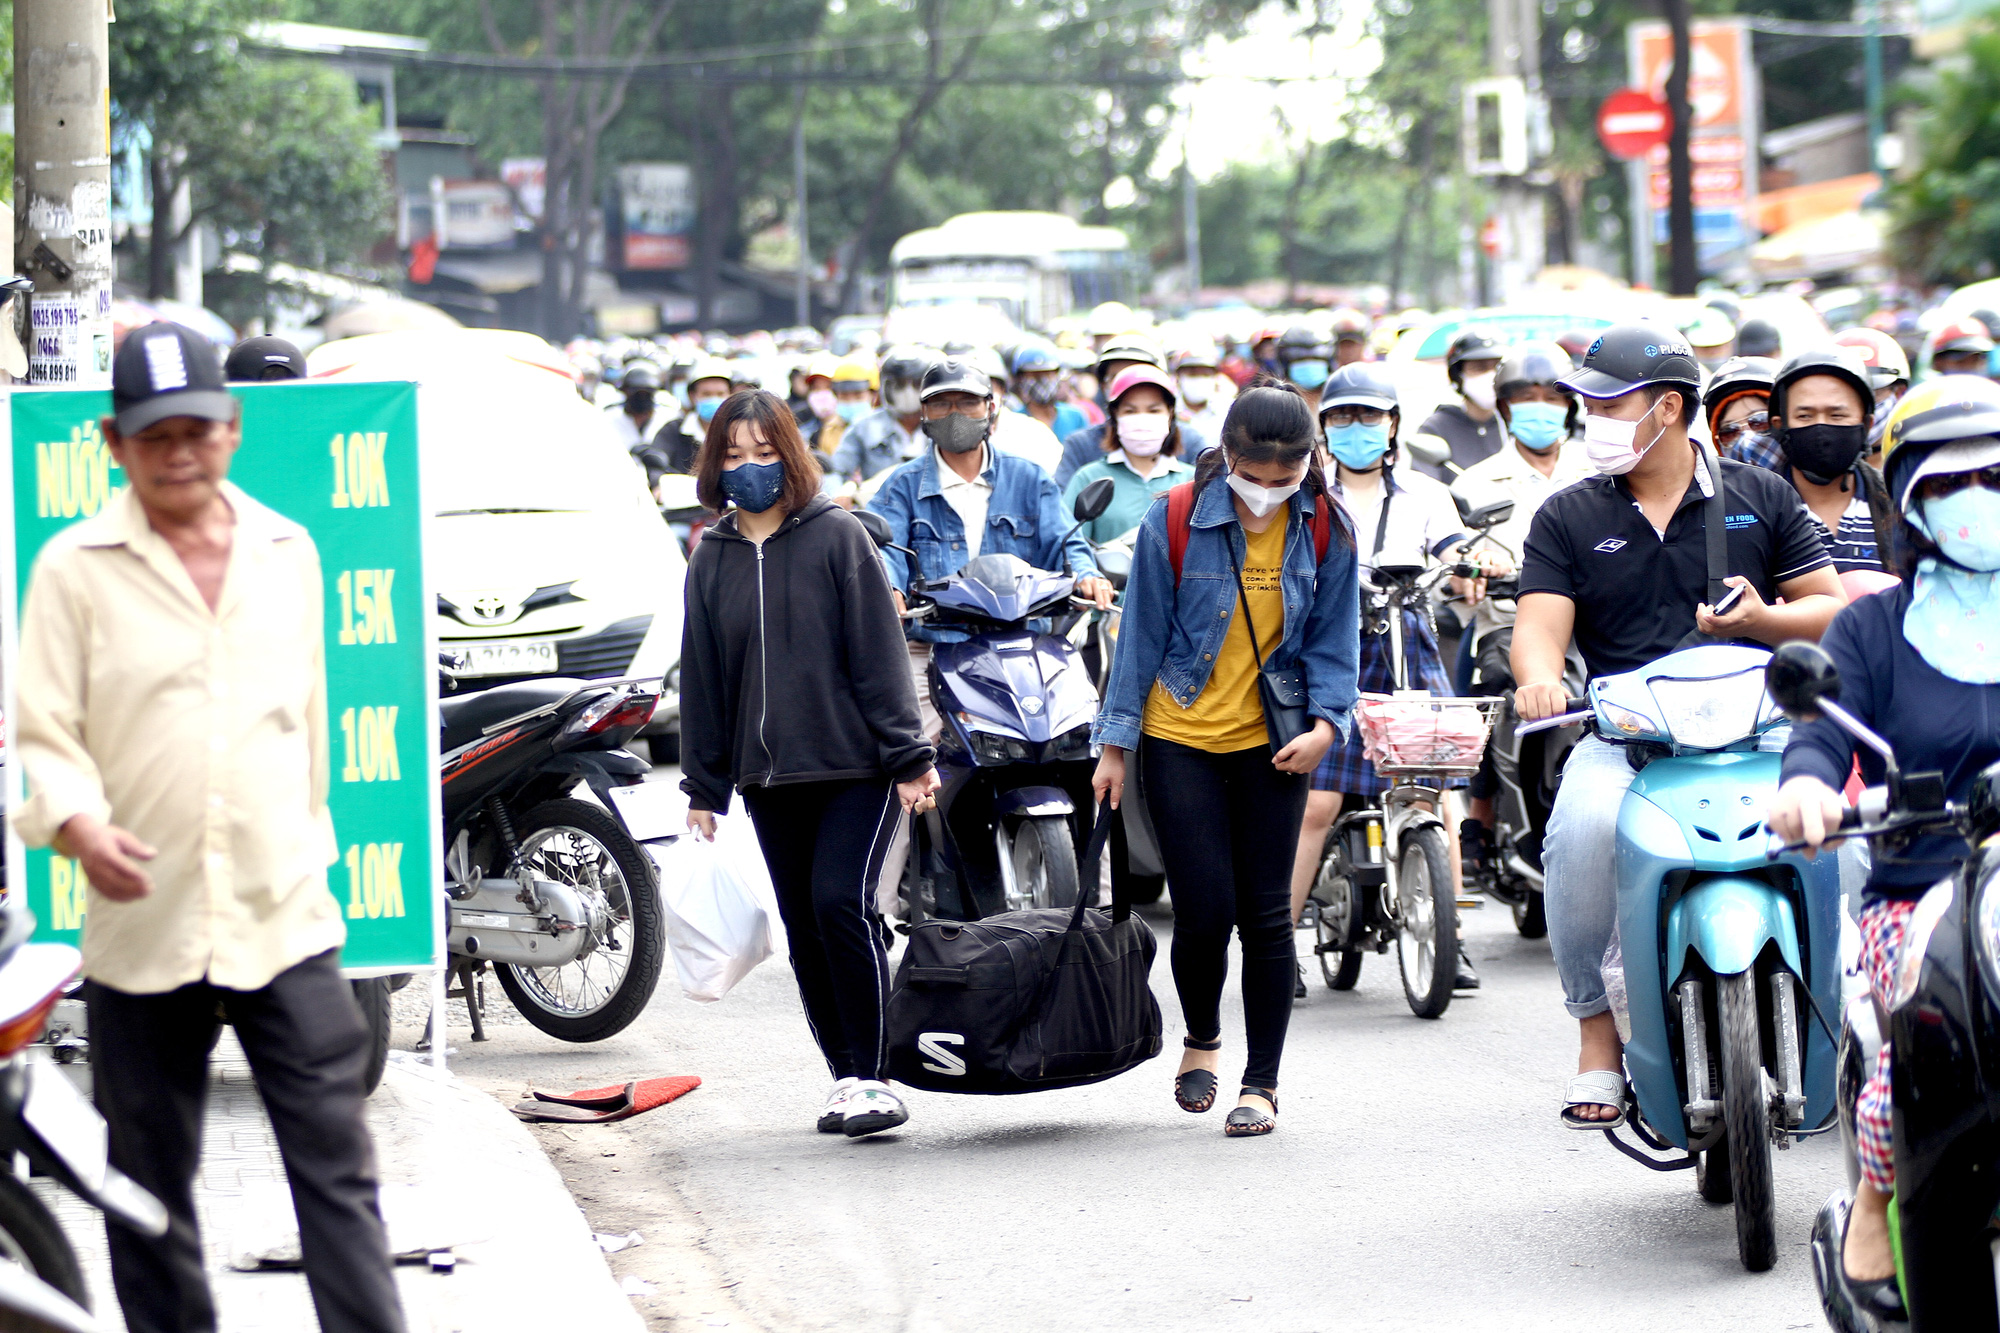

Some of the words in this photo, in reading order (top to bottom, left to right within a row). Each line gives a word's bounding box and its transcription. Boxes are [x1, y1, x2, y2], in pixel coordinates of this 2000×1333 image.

[330, 432, 390, 508] 10K
[336, 570, 397, 645] 15K
[340, 706, 401, 782] 10K
[50, 855, 88, 930] RA
[346, 843, 406, 919] 10K
